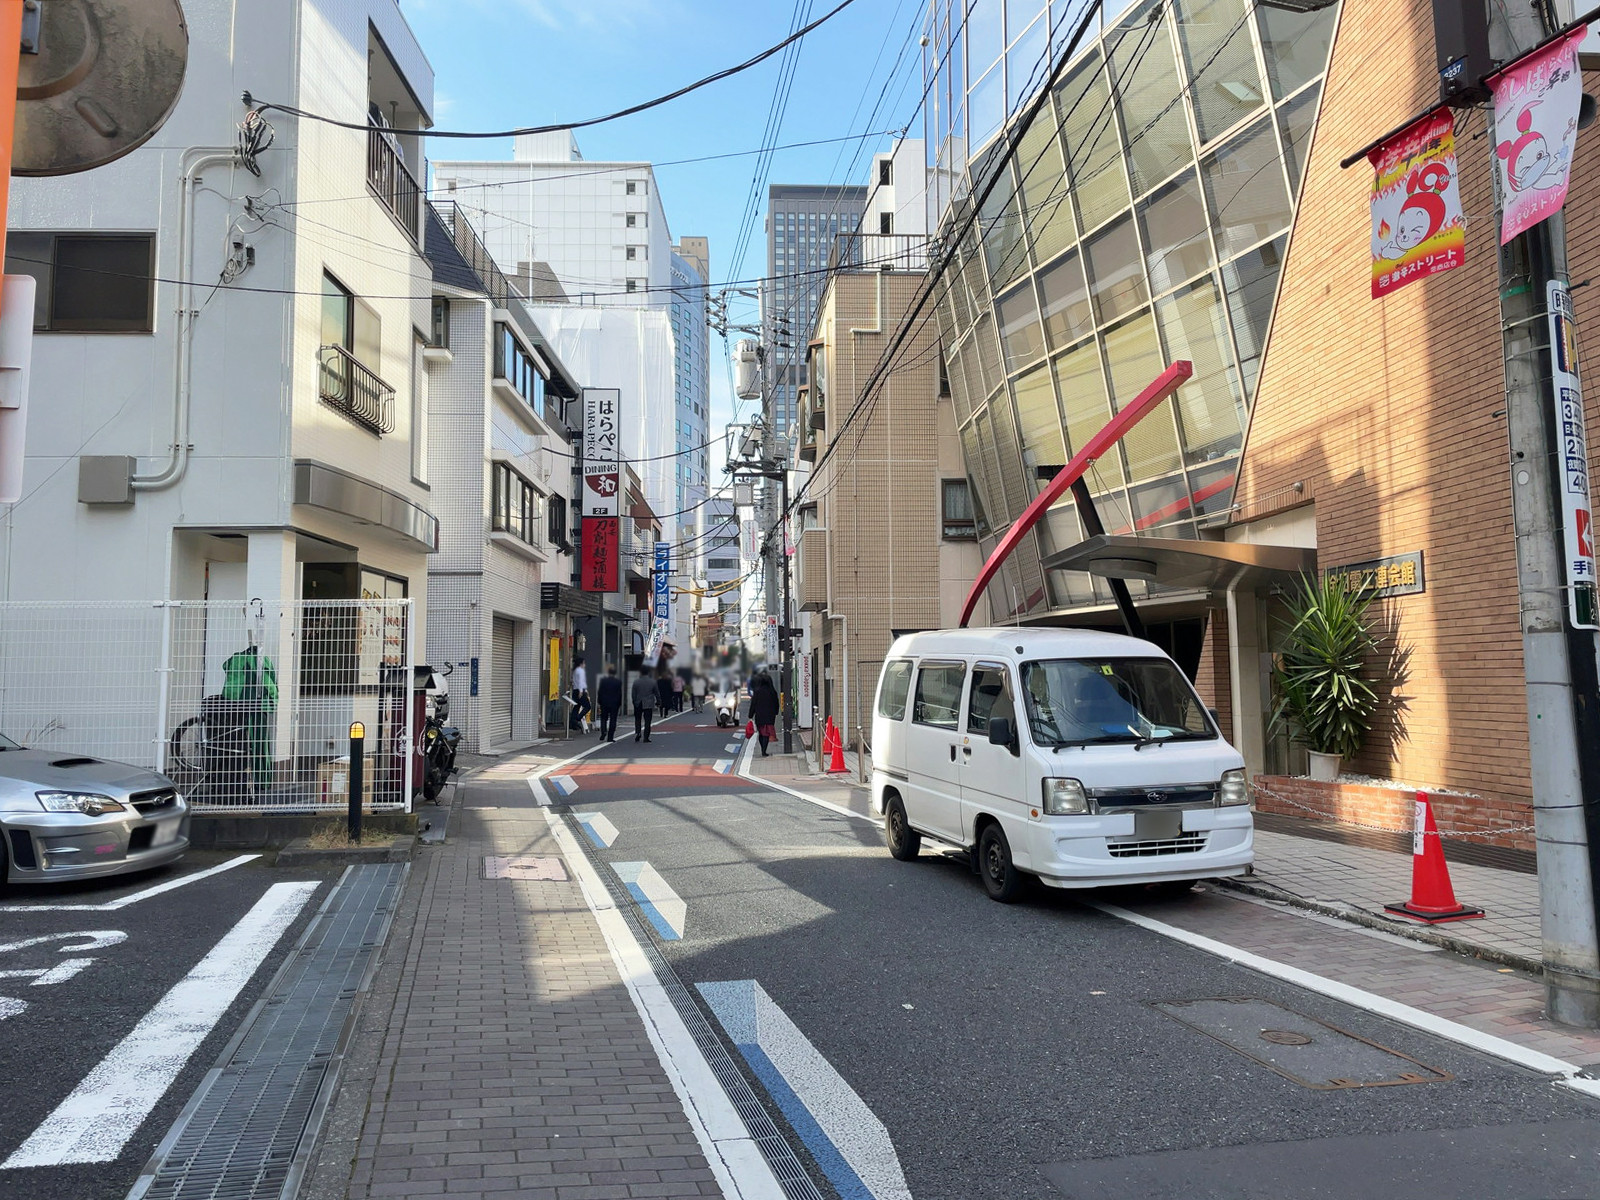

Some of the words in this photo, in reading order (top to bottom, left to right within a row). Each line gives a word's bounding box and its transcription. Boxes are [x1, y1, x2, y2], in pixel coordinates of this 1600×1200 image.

[599, 400, 617, 461] はらぺこ
[584, 464, 617, 474] DINING
[597, 475, 617, 494] 和
[656, 548, 668, 617] ライオン薬局
